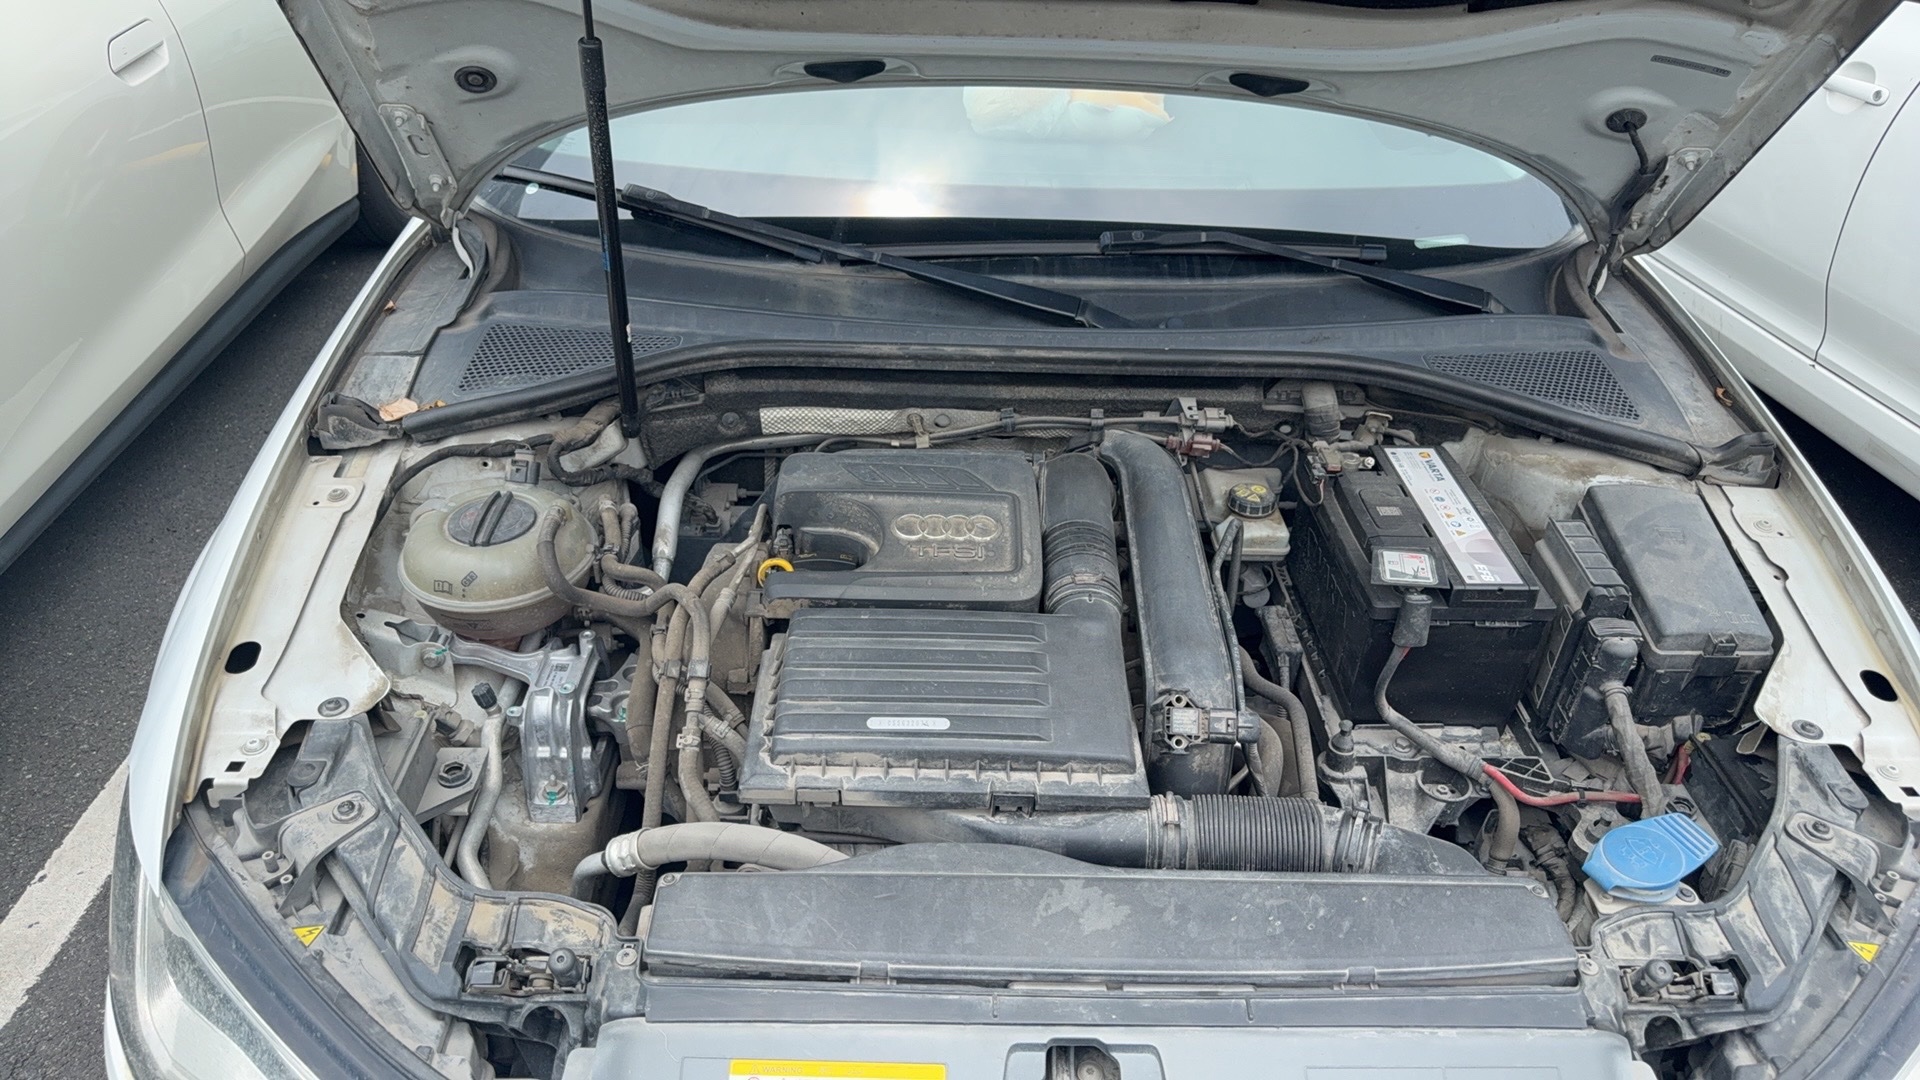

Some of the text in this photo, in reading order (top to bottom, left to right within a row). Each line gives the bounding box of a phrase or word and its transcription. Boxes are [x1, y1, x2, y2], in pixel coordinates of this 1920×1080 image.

[1424, 459, 1445, 481] VARTA
[909, 543, 985, 559] TFSI
[1473, 564, 1495, 582] EFB
[762, 1066, 803, 1074] WARNING
